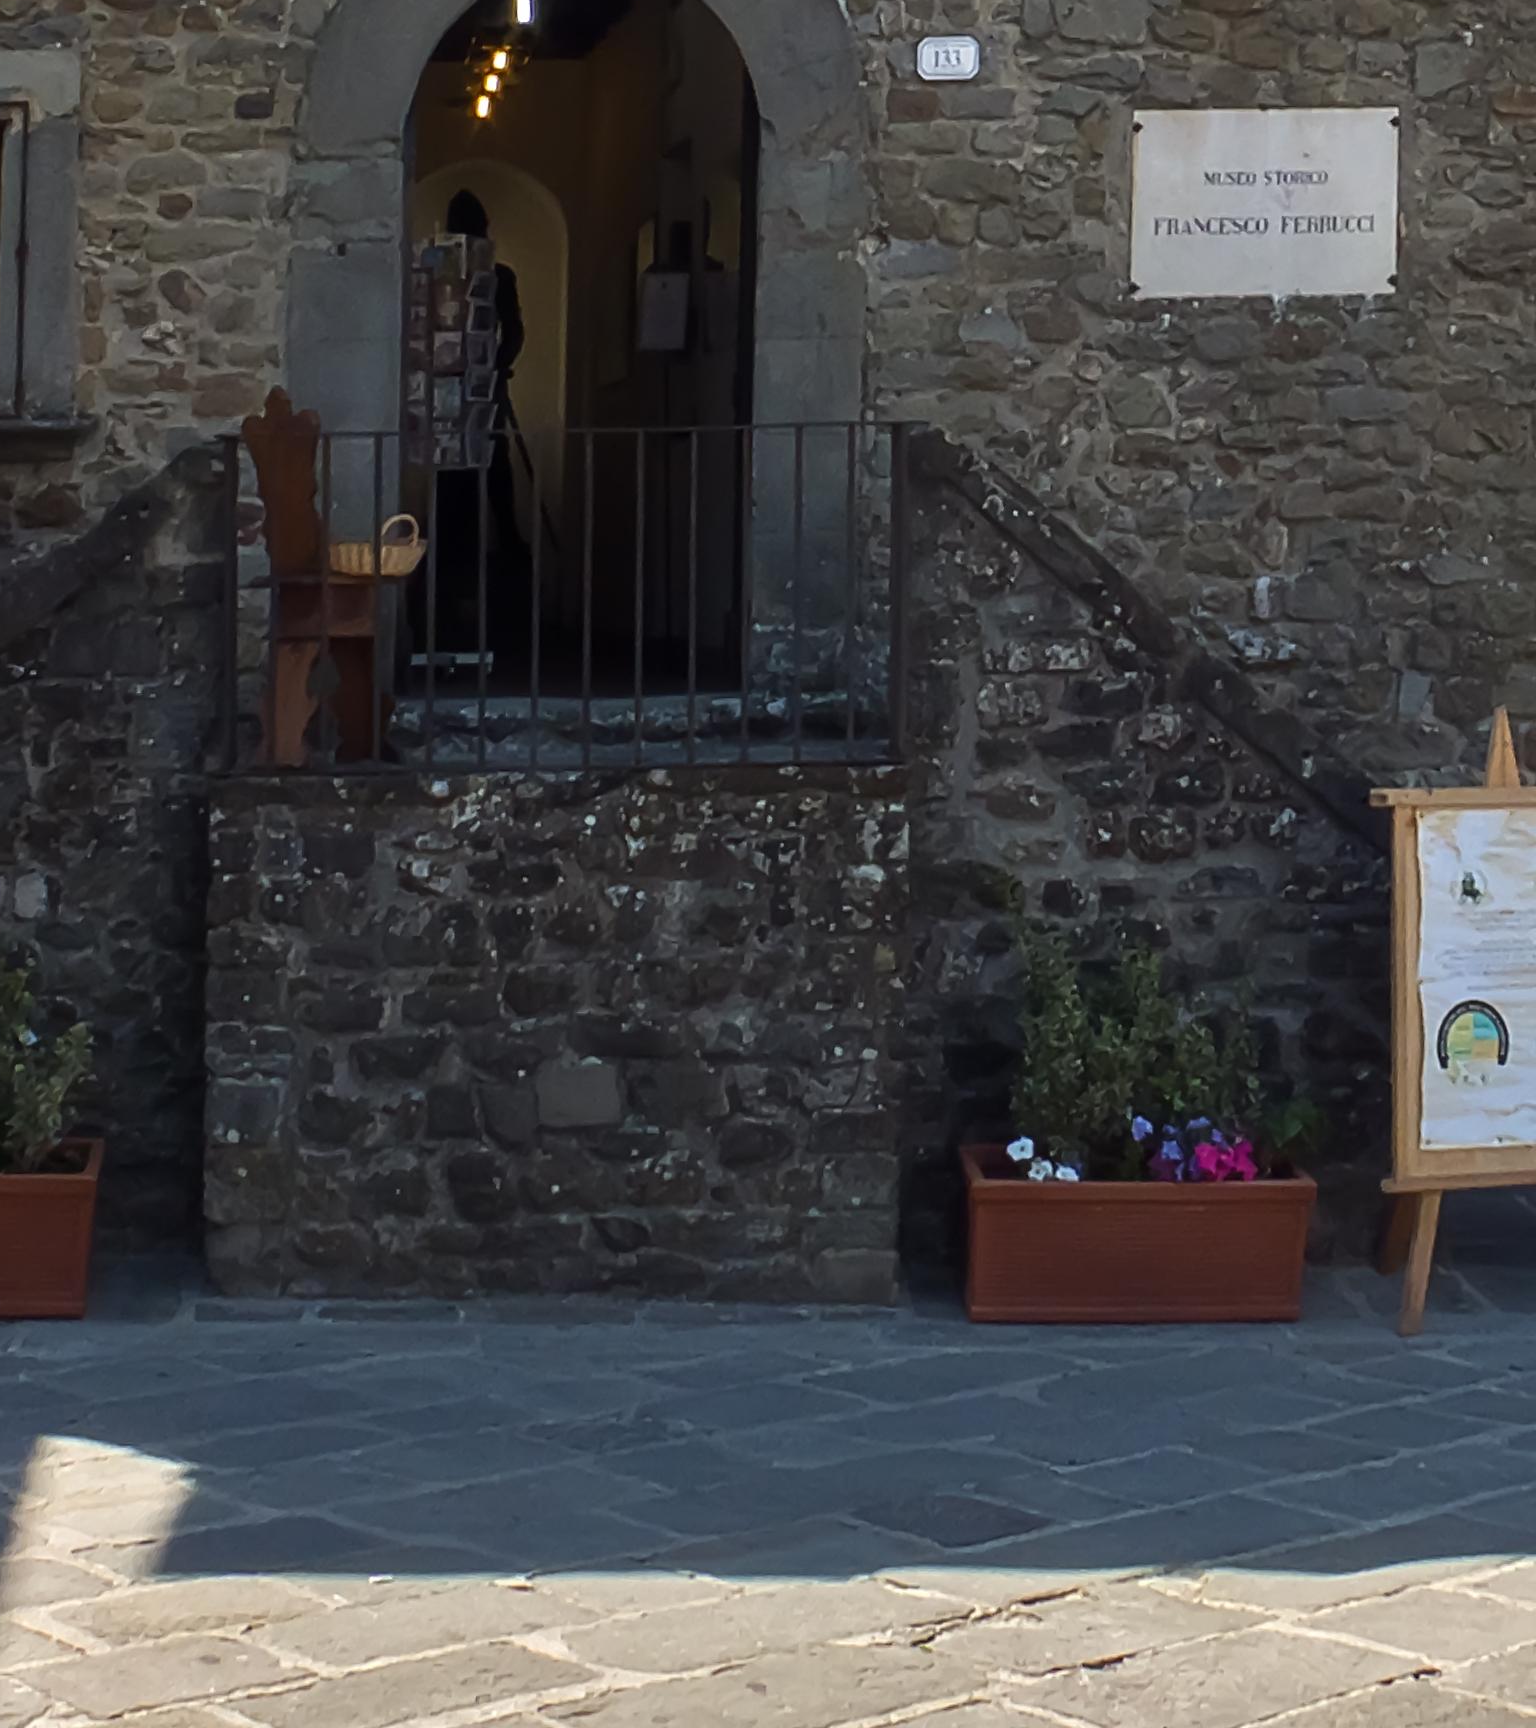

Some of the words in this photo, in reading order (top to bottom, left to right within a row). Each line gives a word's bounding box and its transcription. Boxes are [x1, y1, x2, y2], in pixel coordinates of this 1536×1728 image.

[1203, 170, 1257, 186] MUSEO
[1263, 169, 1329, 185] STORICO
[1153, 216, 1269, 236] FRANCESCO
[1280, 214, 1375, 235] FERRUCCI
